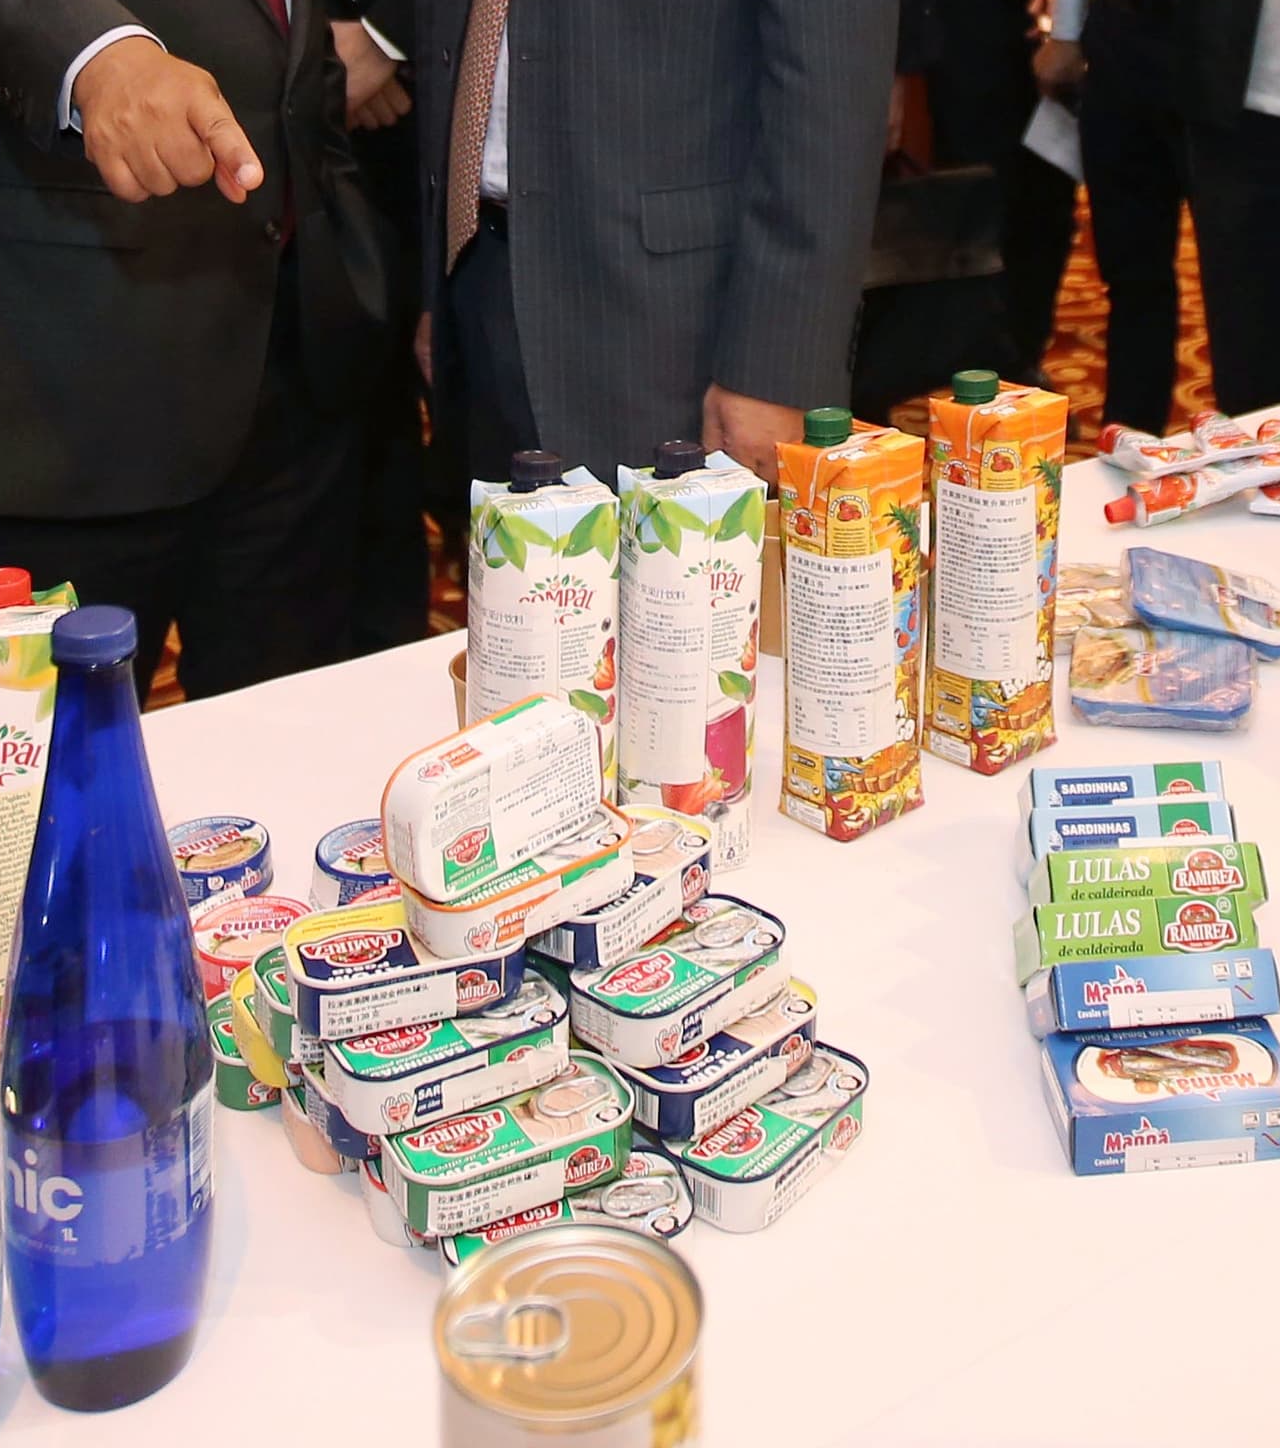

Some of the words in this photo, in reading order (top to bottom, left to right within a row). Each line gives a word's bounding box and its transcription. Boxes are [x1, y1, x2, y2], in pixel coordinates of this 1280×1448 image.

[1061, 781, 1129, 795] SARDINHAS
[1062, 822, 1131, 836] SARDINHAS
[1067, 856, 1151, 884] LULAS
[1178, 869, 1236, 887] RAMIREZ
[1071, 890, 1085, 901] de
[1089, 886, 1153, 901] caldeirada
[1055, 908, 1141, 940] LULAS
[1170, 925, 1229, 943] RAMIREZ
[315, 933, 394, 956] RAMIREZ
[1058, 947, 1073, 957] de
[1076, 942, 1144, 957] caldeirada
[353, 1027, 401, 1050] ANOS
[419, 1114, 495, 1147] RAMIREZ
[703, 1109, 758, 1157] RAMIREZ
[563, 1159, 609, 1180] AMIREZ
[522, 1205, 554, 1219] 160
[62, 1228, 78, 1242] 1L
